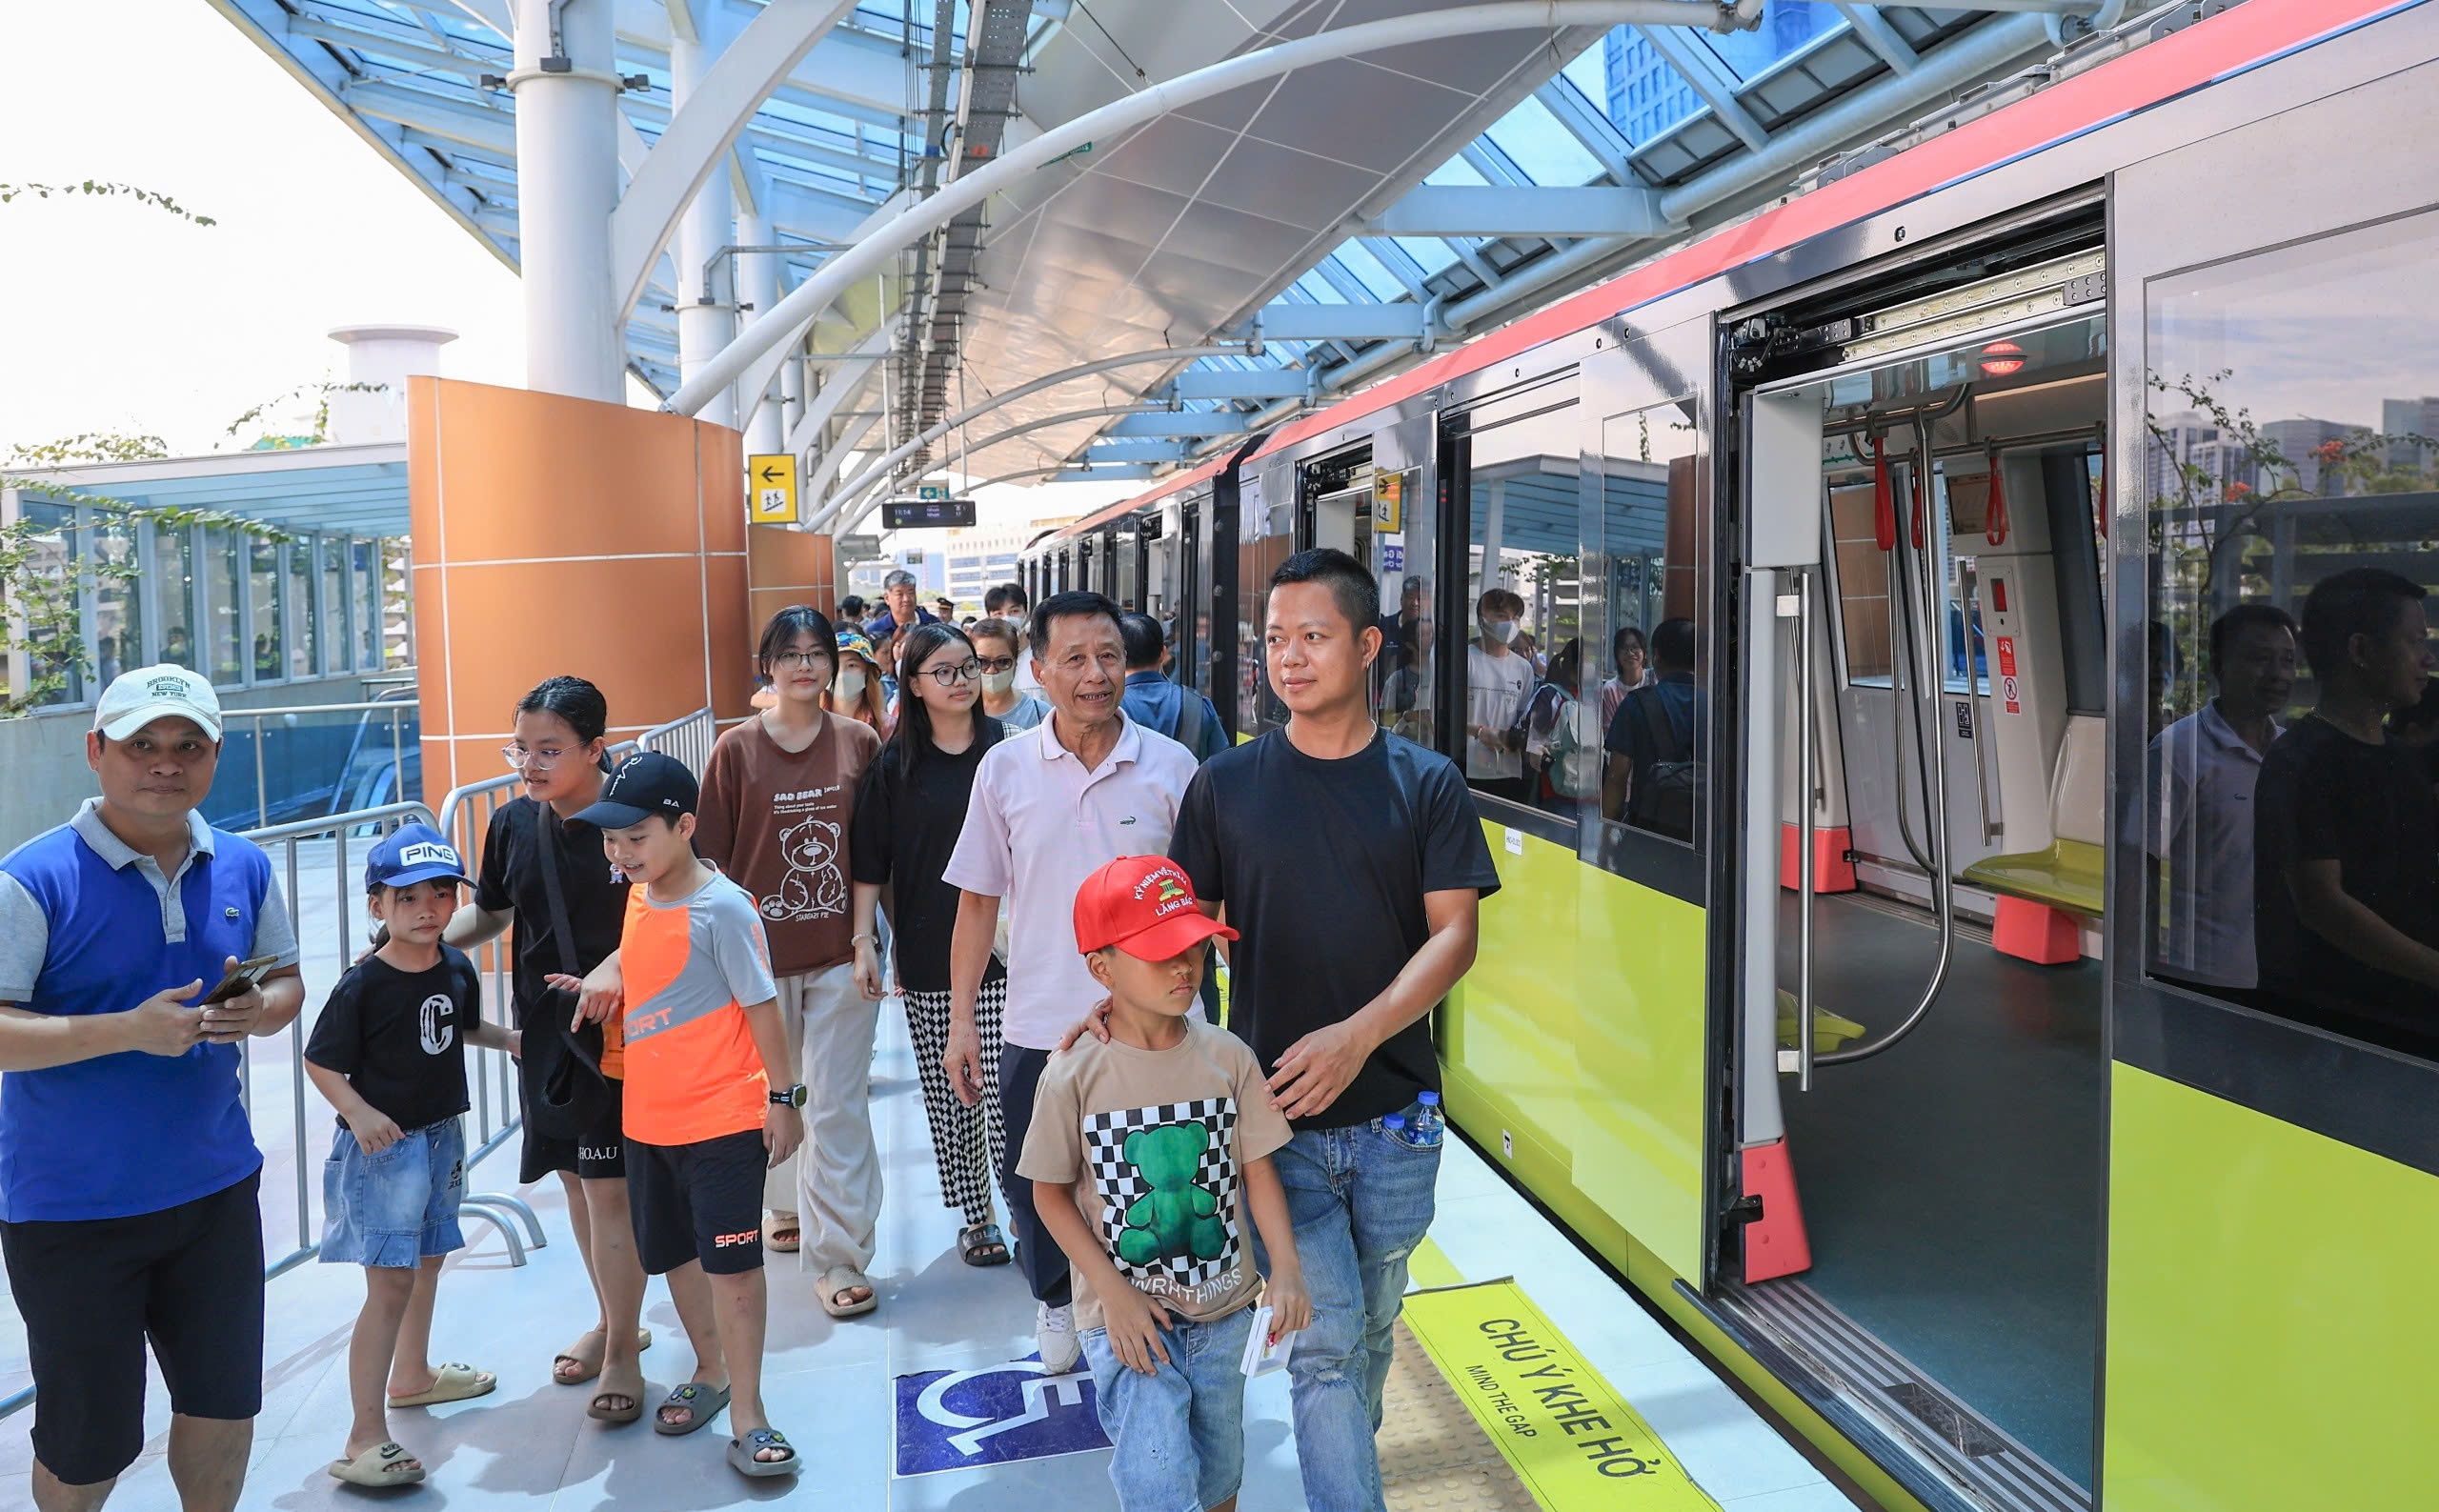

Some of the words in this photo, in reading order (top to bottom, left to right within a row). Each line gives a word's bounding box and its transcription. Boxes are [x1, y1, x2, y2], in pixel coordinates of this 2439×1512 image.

[146, 675, 191, 690] BROOKLYN
[796, 789, 822, 800] BEAR
[406, 845, 454, 861] PING
[1155, 901, 1180, 917] LĂNG
[577, 1146, 618, 1160] HO.A.U
[716, 1230, 758, 1248] SPORT
[1479, 1319, 1557, 1362] CHÚ
[1519, 1362, 1576, 1380] Ý
[1465, 1364, 1500, 1391] MIND
[1488, 1391, 1519, 1415] THE
[1504, 1415, 1538, 1439] GAP
[1532, 1382, 1613, 1436] KHE
[1577, 1435, 1663, 1479] HỞ
